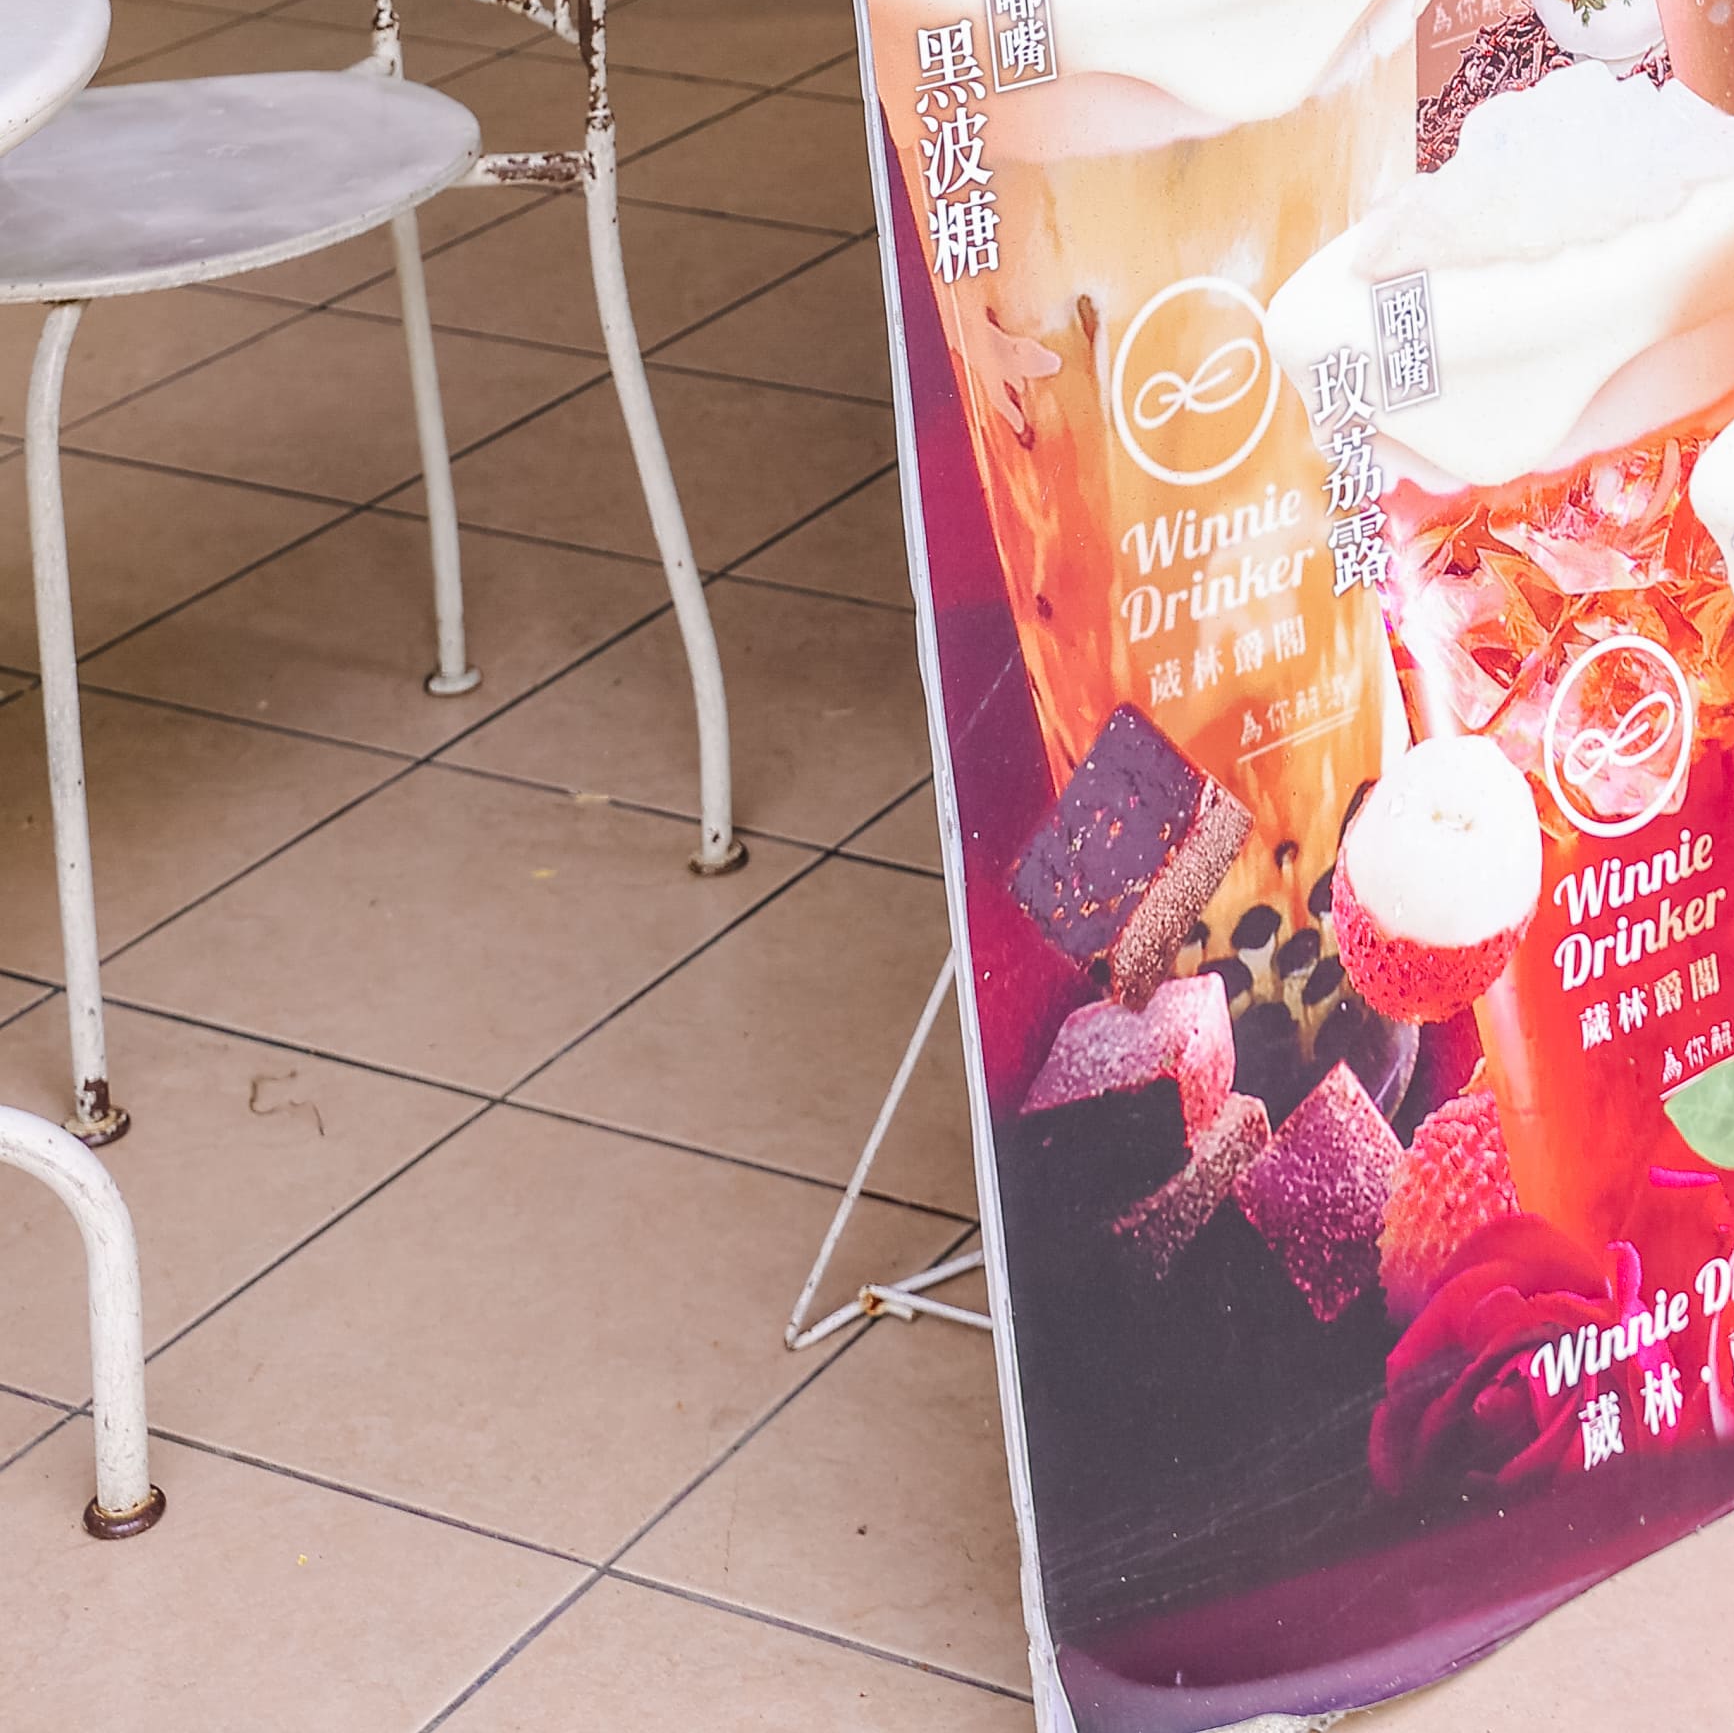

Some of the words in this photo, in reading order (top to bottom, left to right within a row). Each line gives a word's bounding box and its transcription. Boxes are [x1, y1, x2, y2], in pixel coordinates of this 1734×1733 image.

[914, 18, 1001, 285] 黑波糖
[1381, 285, 1431, 398] 嘟嘴
[1309, 347, 1391, 598] 玫荔露
[1120, 483, 1302, 576] Winnie
[1119, 546, 1316, 644] Drinker
[1553, 828, 1714, 927] Winnie
[1553, 887, 1727, 992] Drinker
[1530, 1288, 1690, 1397] Winnie
